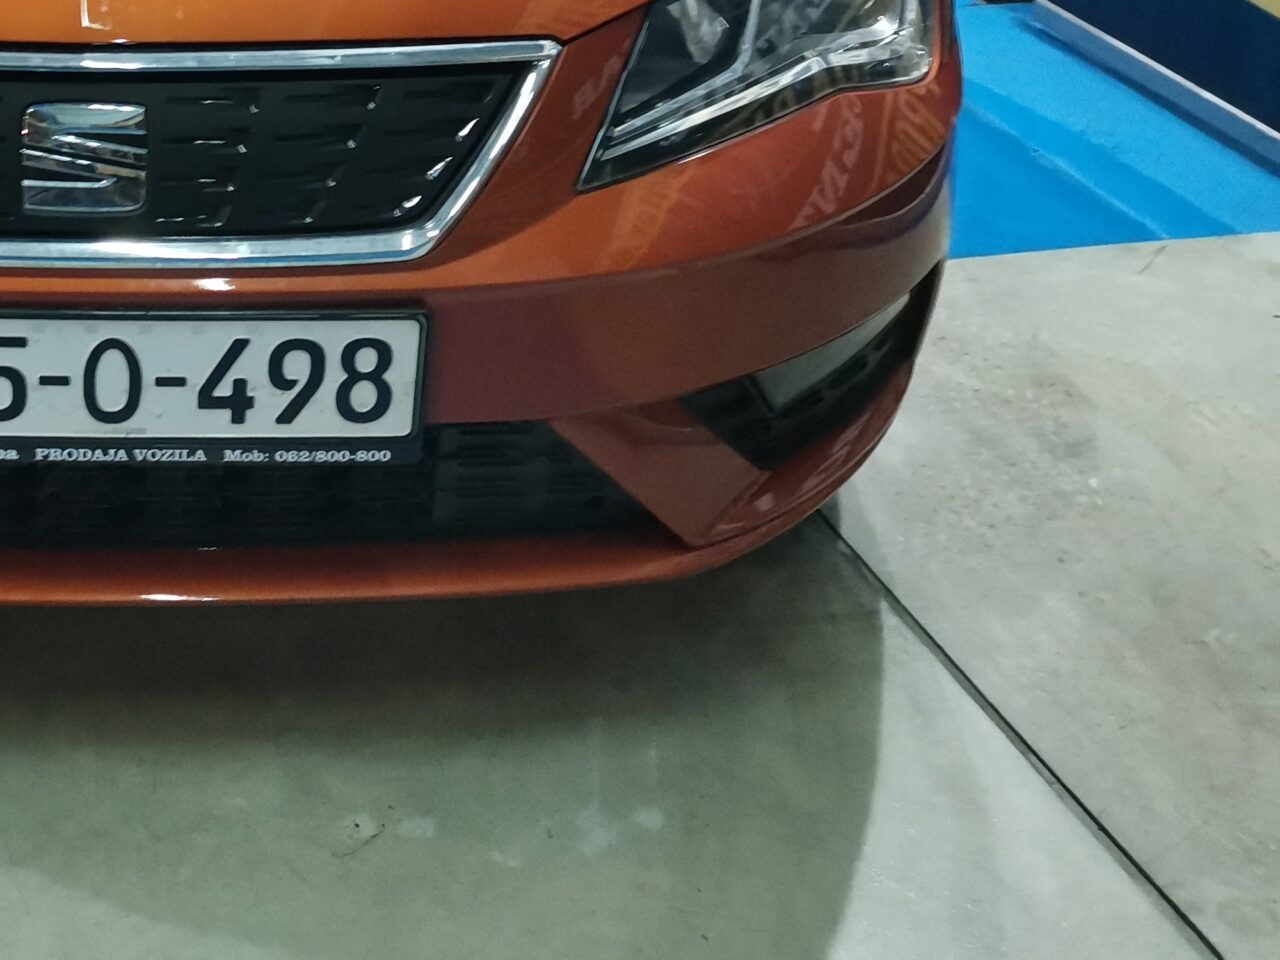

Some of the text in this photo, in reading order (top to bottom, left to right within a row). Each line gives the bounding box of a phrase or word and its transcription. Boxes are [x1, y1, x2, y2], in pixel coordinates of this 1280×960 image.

[34, 448, 129, 461] PRODAJA
[132, 449, 207, 462] VOZILA
[223, 449, 269, 462] Mob:
